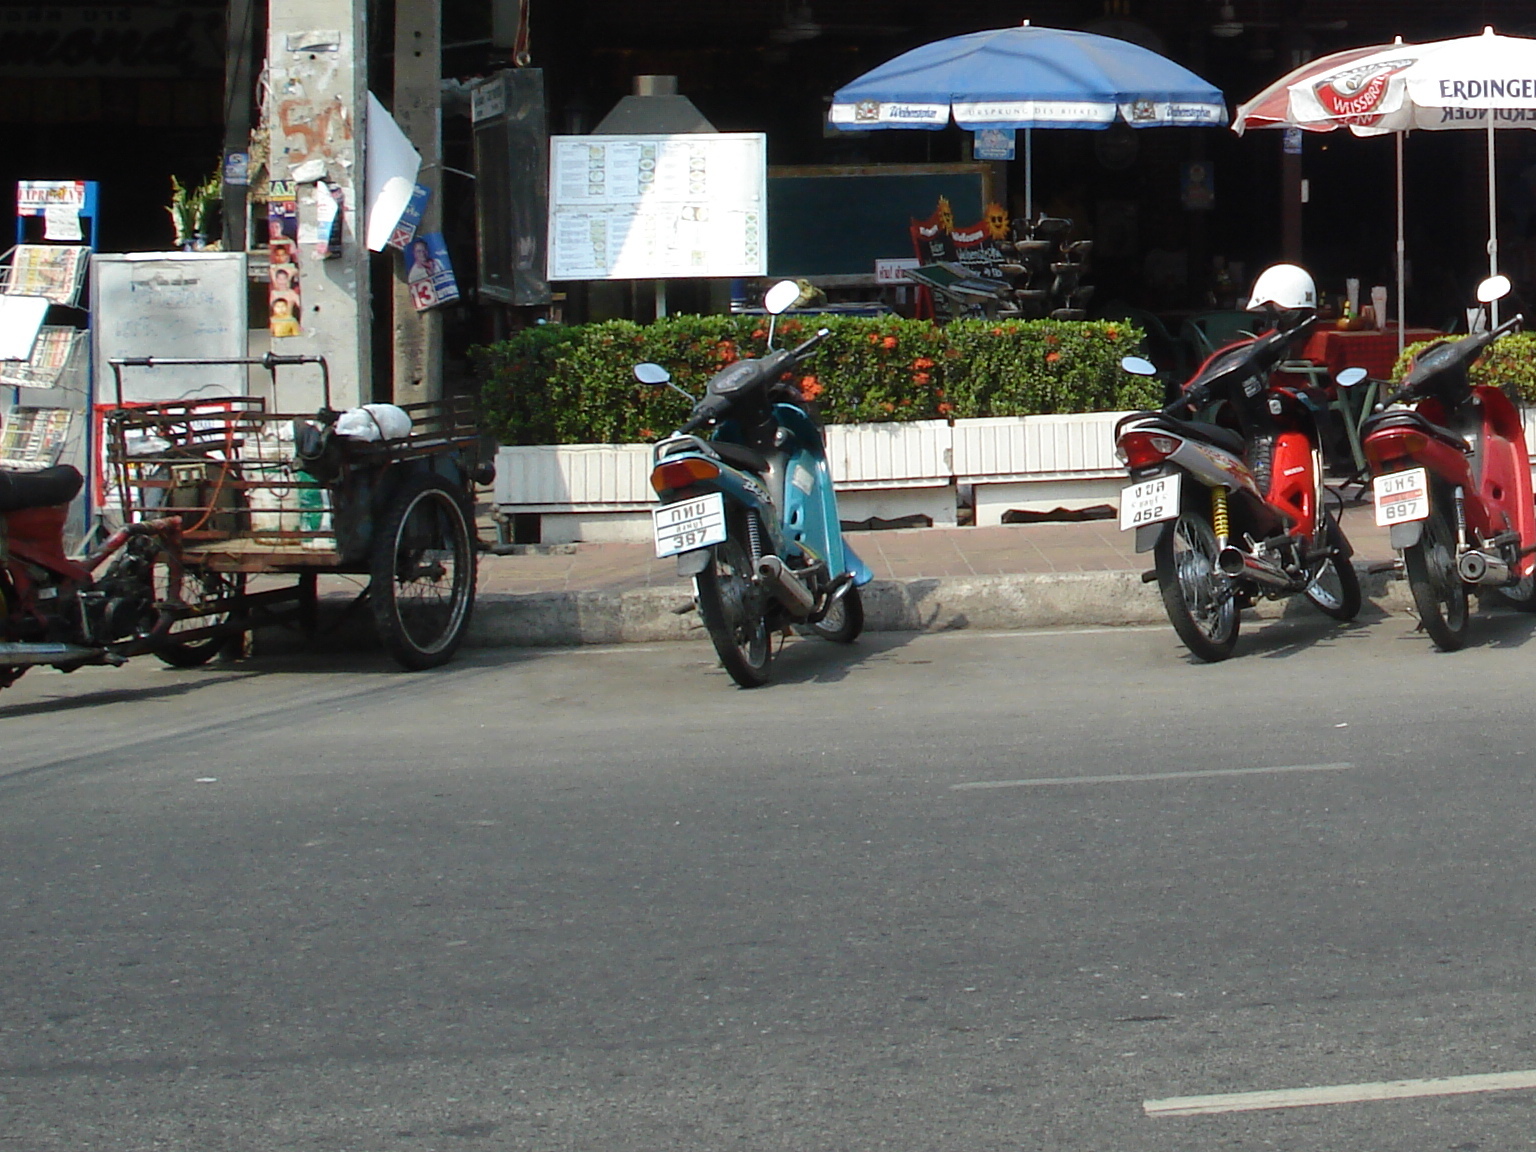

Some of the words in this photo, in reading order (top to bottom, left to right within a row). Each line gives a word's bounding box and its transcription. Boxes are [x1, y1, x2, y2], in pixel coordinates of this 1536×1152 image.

[411, 279, 437, 309] 13
[1133, 505, 1164, 523] 452
[1386, 502, 1417, 519] 697
[673, 529, 708, 549] 387
